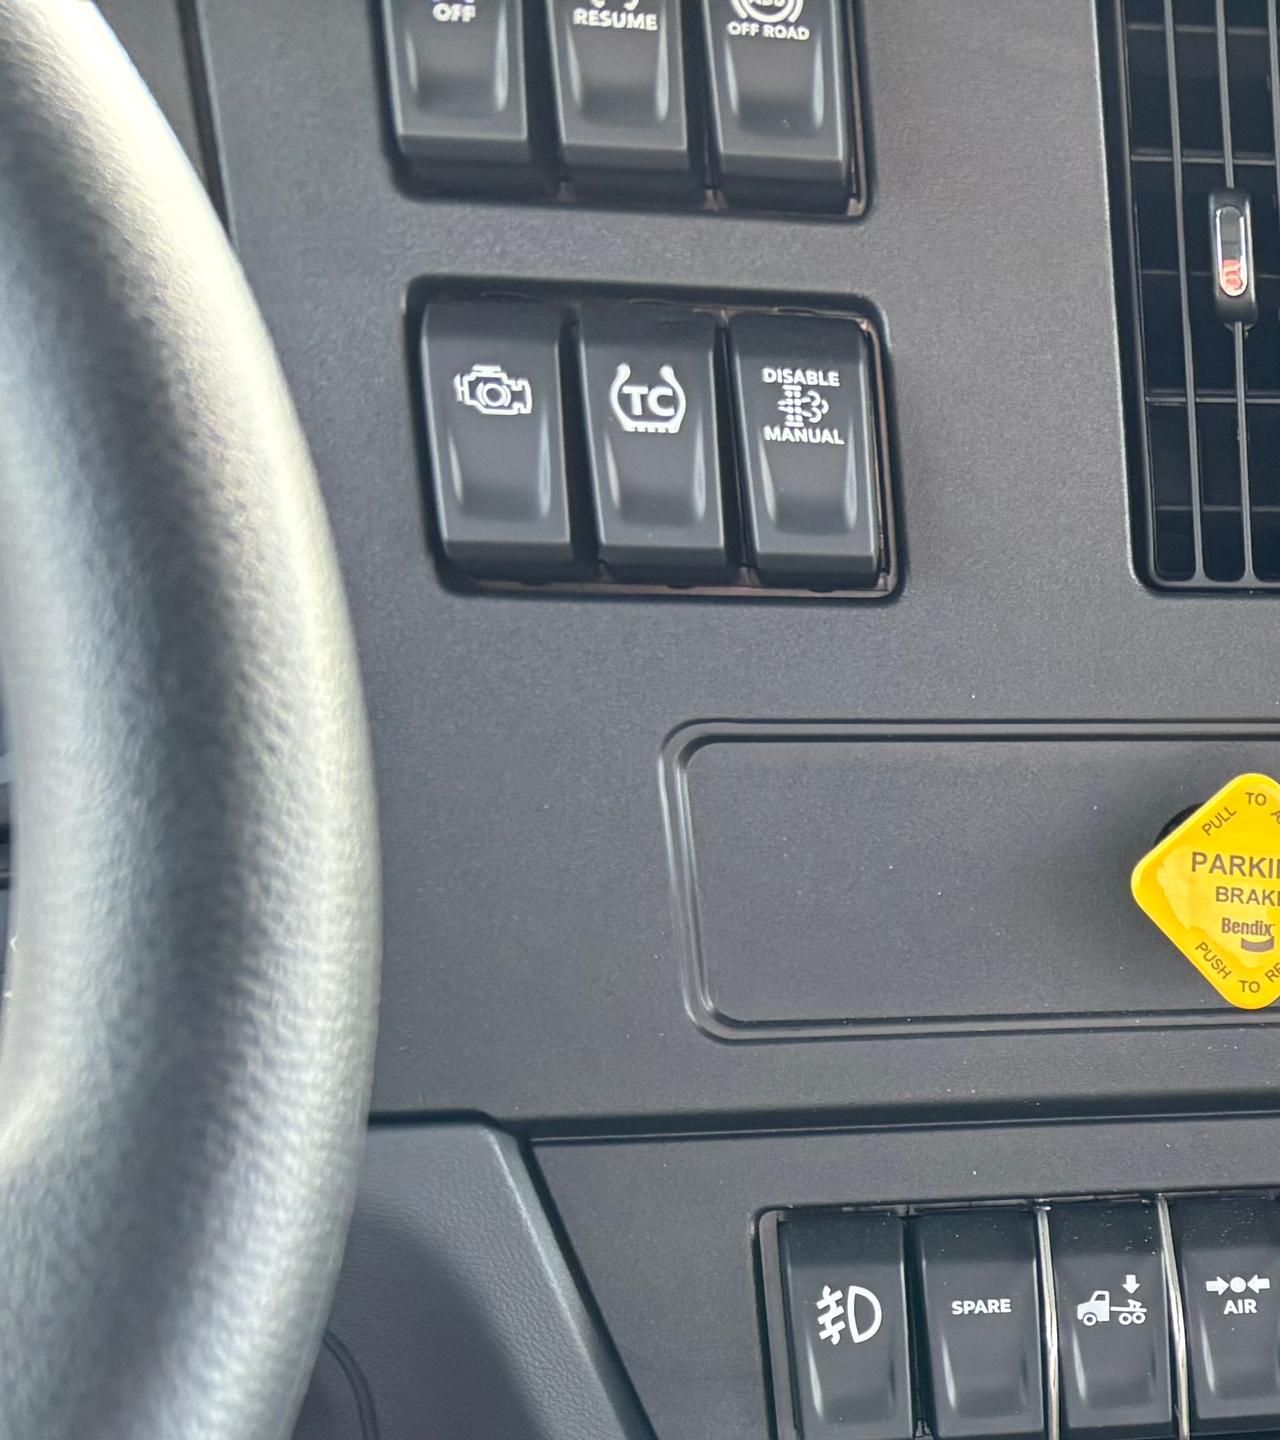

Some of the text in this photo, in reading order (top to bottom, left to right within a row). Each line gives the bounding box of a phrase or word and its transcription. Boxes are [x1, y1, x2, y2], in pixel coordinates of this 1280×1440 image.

[432, 3, 476, 23] OFF
[573, 8, 658, 32] RESUME
[726, 21, 810, 40] OFF ROAD
[761, 367, 841, 388] DISABLE
[622, 386, 676, 417] TC
[763, 425, 845, 446] MANUAL
[1202, 806, 1237, 837] PULL
[1245, 792, 1267, 806] TO
[1221, 917, 1274, 937] Bendix
[1195, 941, 1232, 980] PUSH
[1238, 980, 1261, 994] TO
[951, 1298, 1012, 1316] SPARE
[1224, 1298, 1258, 1315] AIR
